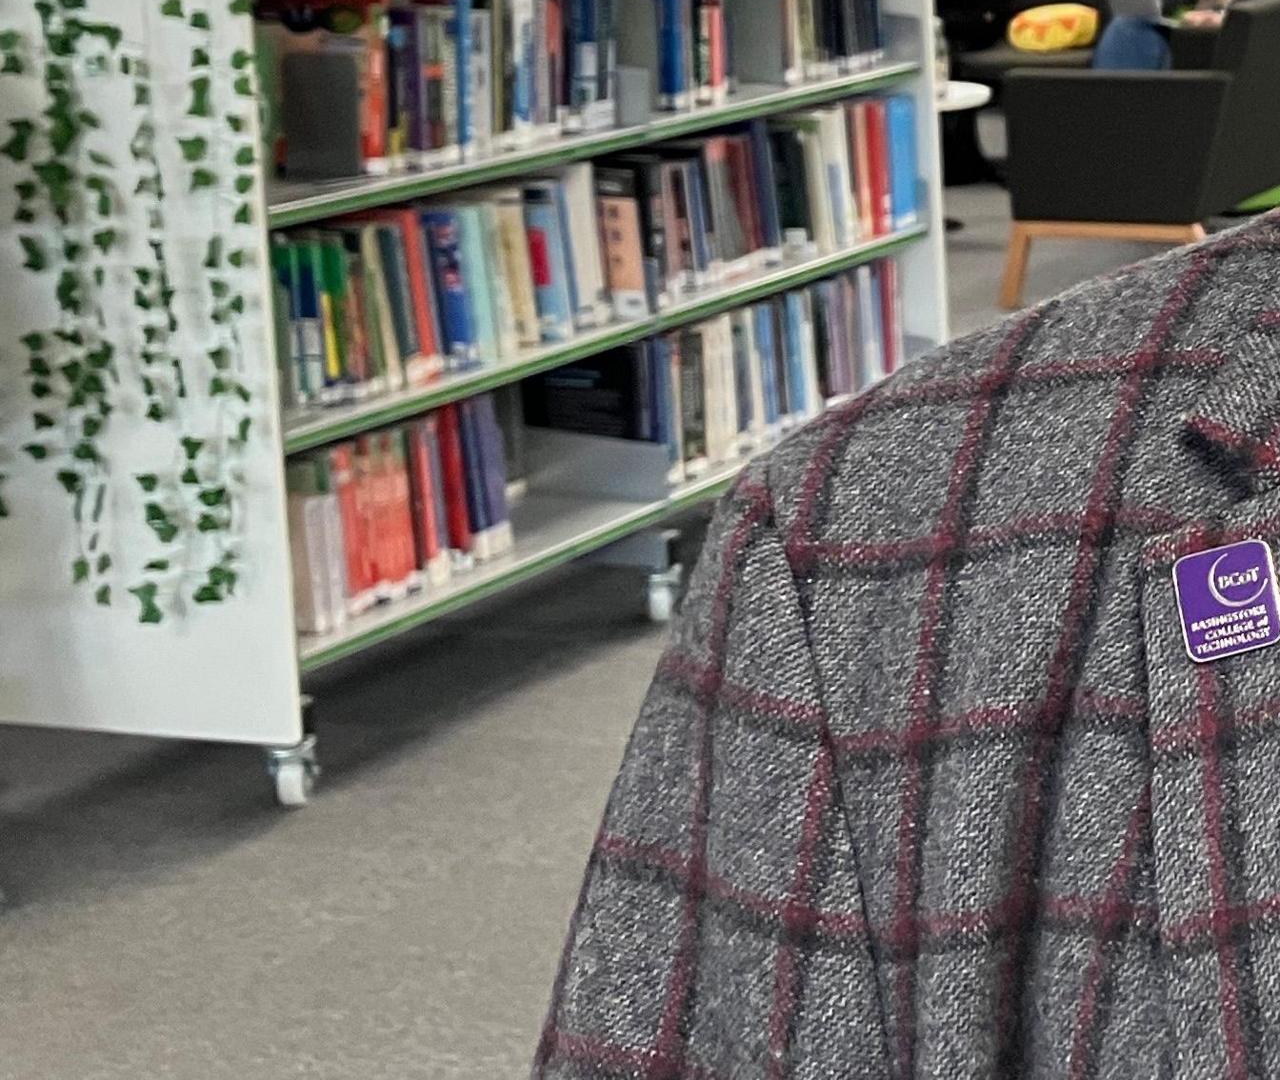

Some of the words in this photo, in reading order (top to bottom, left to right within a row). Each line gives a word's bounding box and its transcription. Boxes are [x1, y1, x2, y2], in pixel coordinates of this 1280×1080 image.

[1191, 604, 1267, 632] BASINGSTOKE
[1204, 619, 1255, 641] COLLEGE
[1257, 615, 1269, 628] of
[1195, 626, 1271, 654] TECHNOLOGY
